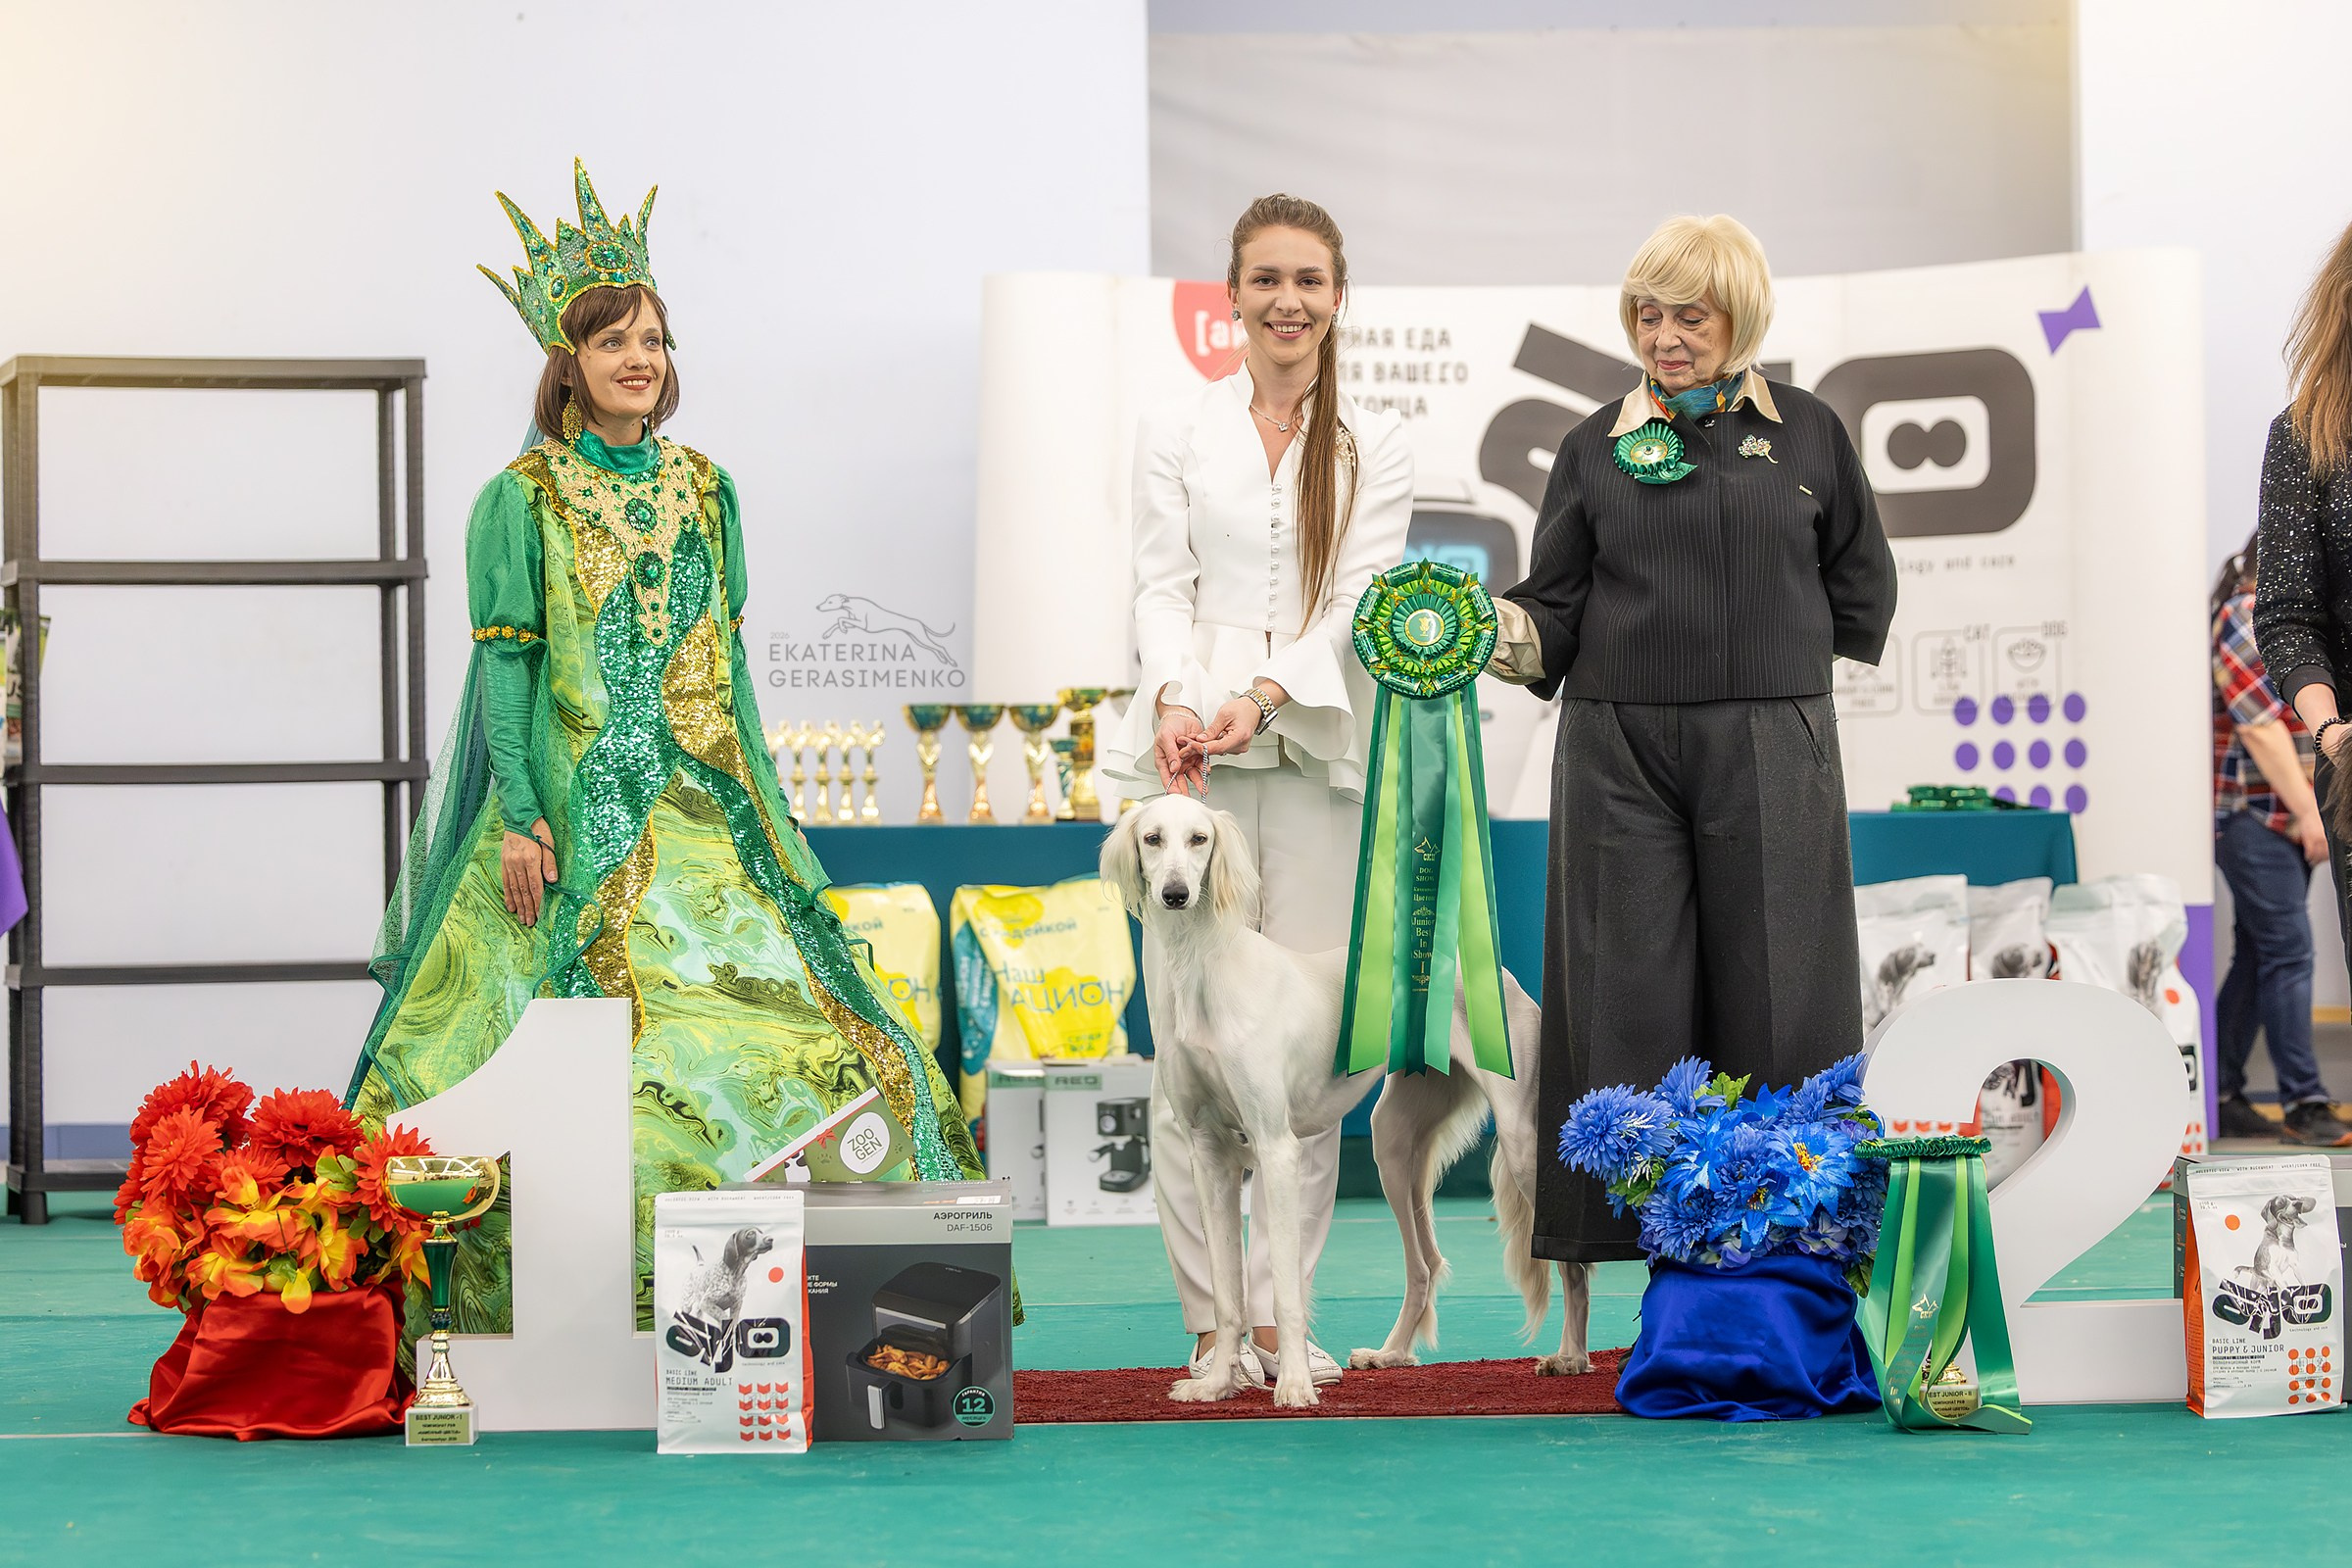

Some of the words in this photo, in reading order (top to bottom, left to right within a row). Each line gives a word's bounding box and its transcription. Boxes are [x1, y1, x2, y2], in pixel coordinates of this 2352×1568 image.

[1405, 327, 1451, 351] ЕДА
[1374, 362, 1469, 383] ВАШЕГО
[1412, 916, 1435, 926] Junior
[1420, 938, 1428, 948] In
[1413, 949, 1432, 959] Show
[847, 1128, 874, 1152] ZOO
[855, 1137, 883, 1160] GEN
[1862, 977, 2191, 1405] 2
[386, 997, 662, 1432] 1
[933, 1211, 993, 1220] АЭРОГРИЛЬ
[947, 1223, 993, 1232] DAF-1506
[2251, 1344, 2284, 1353] JUNIOR
[666, 1377, 698, 1386] MEDIUM
[705, 1377, 732, 1386] ADULT
[961, 1397, 986, 1412] 12
